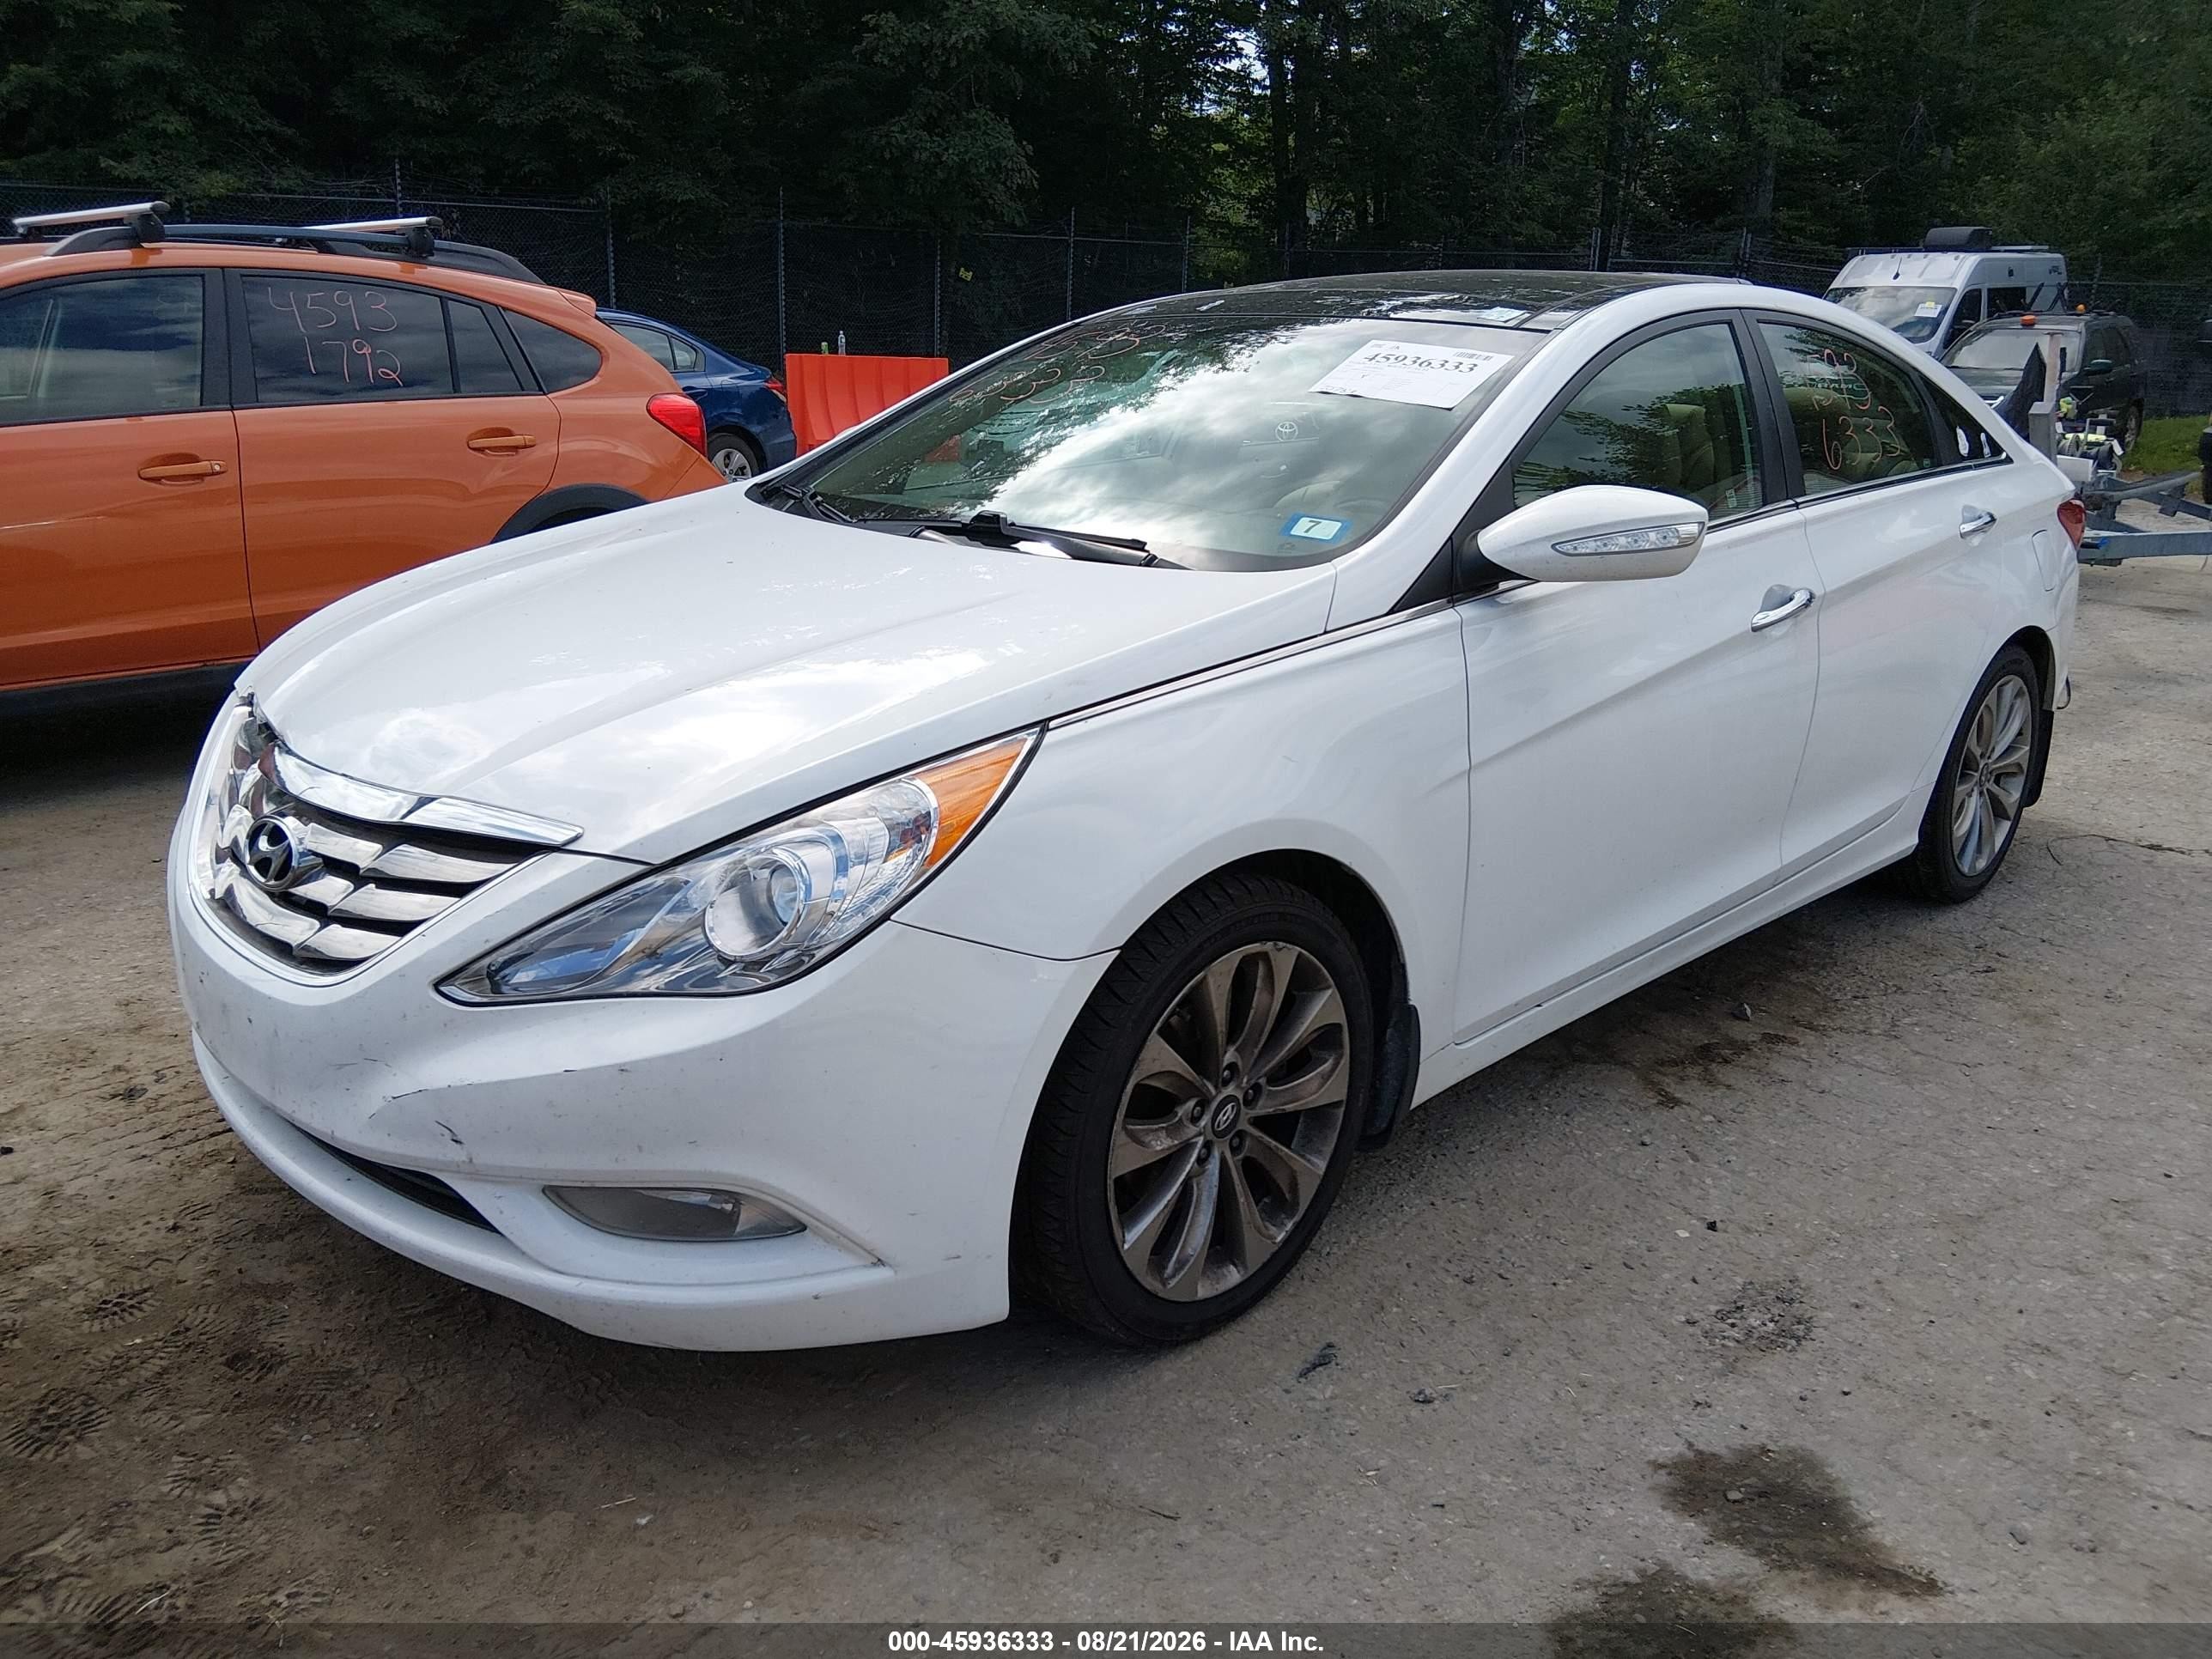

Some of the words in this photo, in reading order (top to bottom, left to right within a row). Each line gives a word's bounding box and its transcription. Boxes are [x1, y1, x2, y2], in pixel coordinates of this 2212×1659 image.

[268, 287, 398, 333] 4593
[304, 336, 404, 386] 1792
[1363, 352, 1480, 374] 45936333
[1822, 405, 1901, 471] 6333
[1304, 520, 1322, 534] 7
